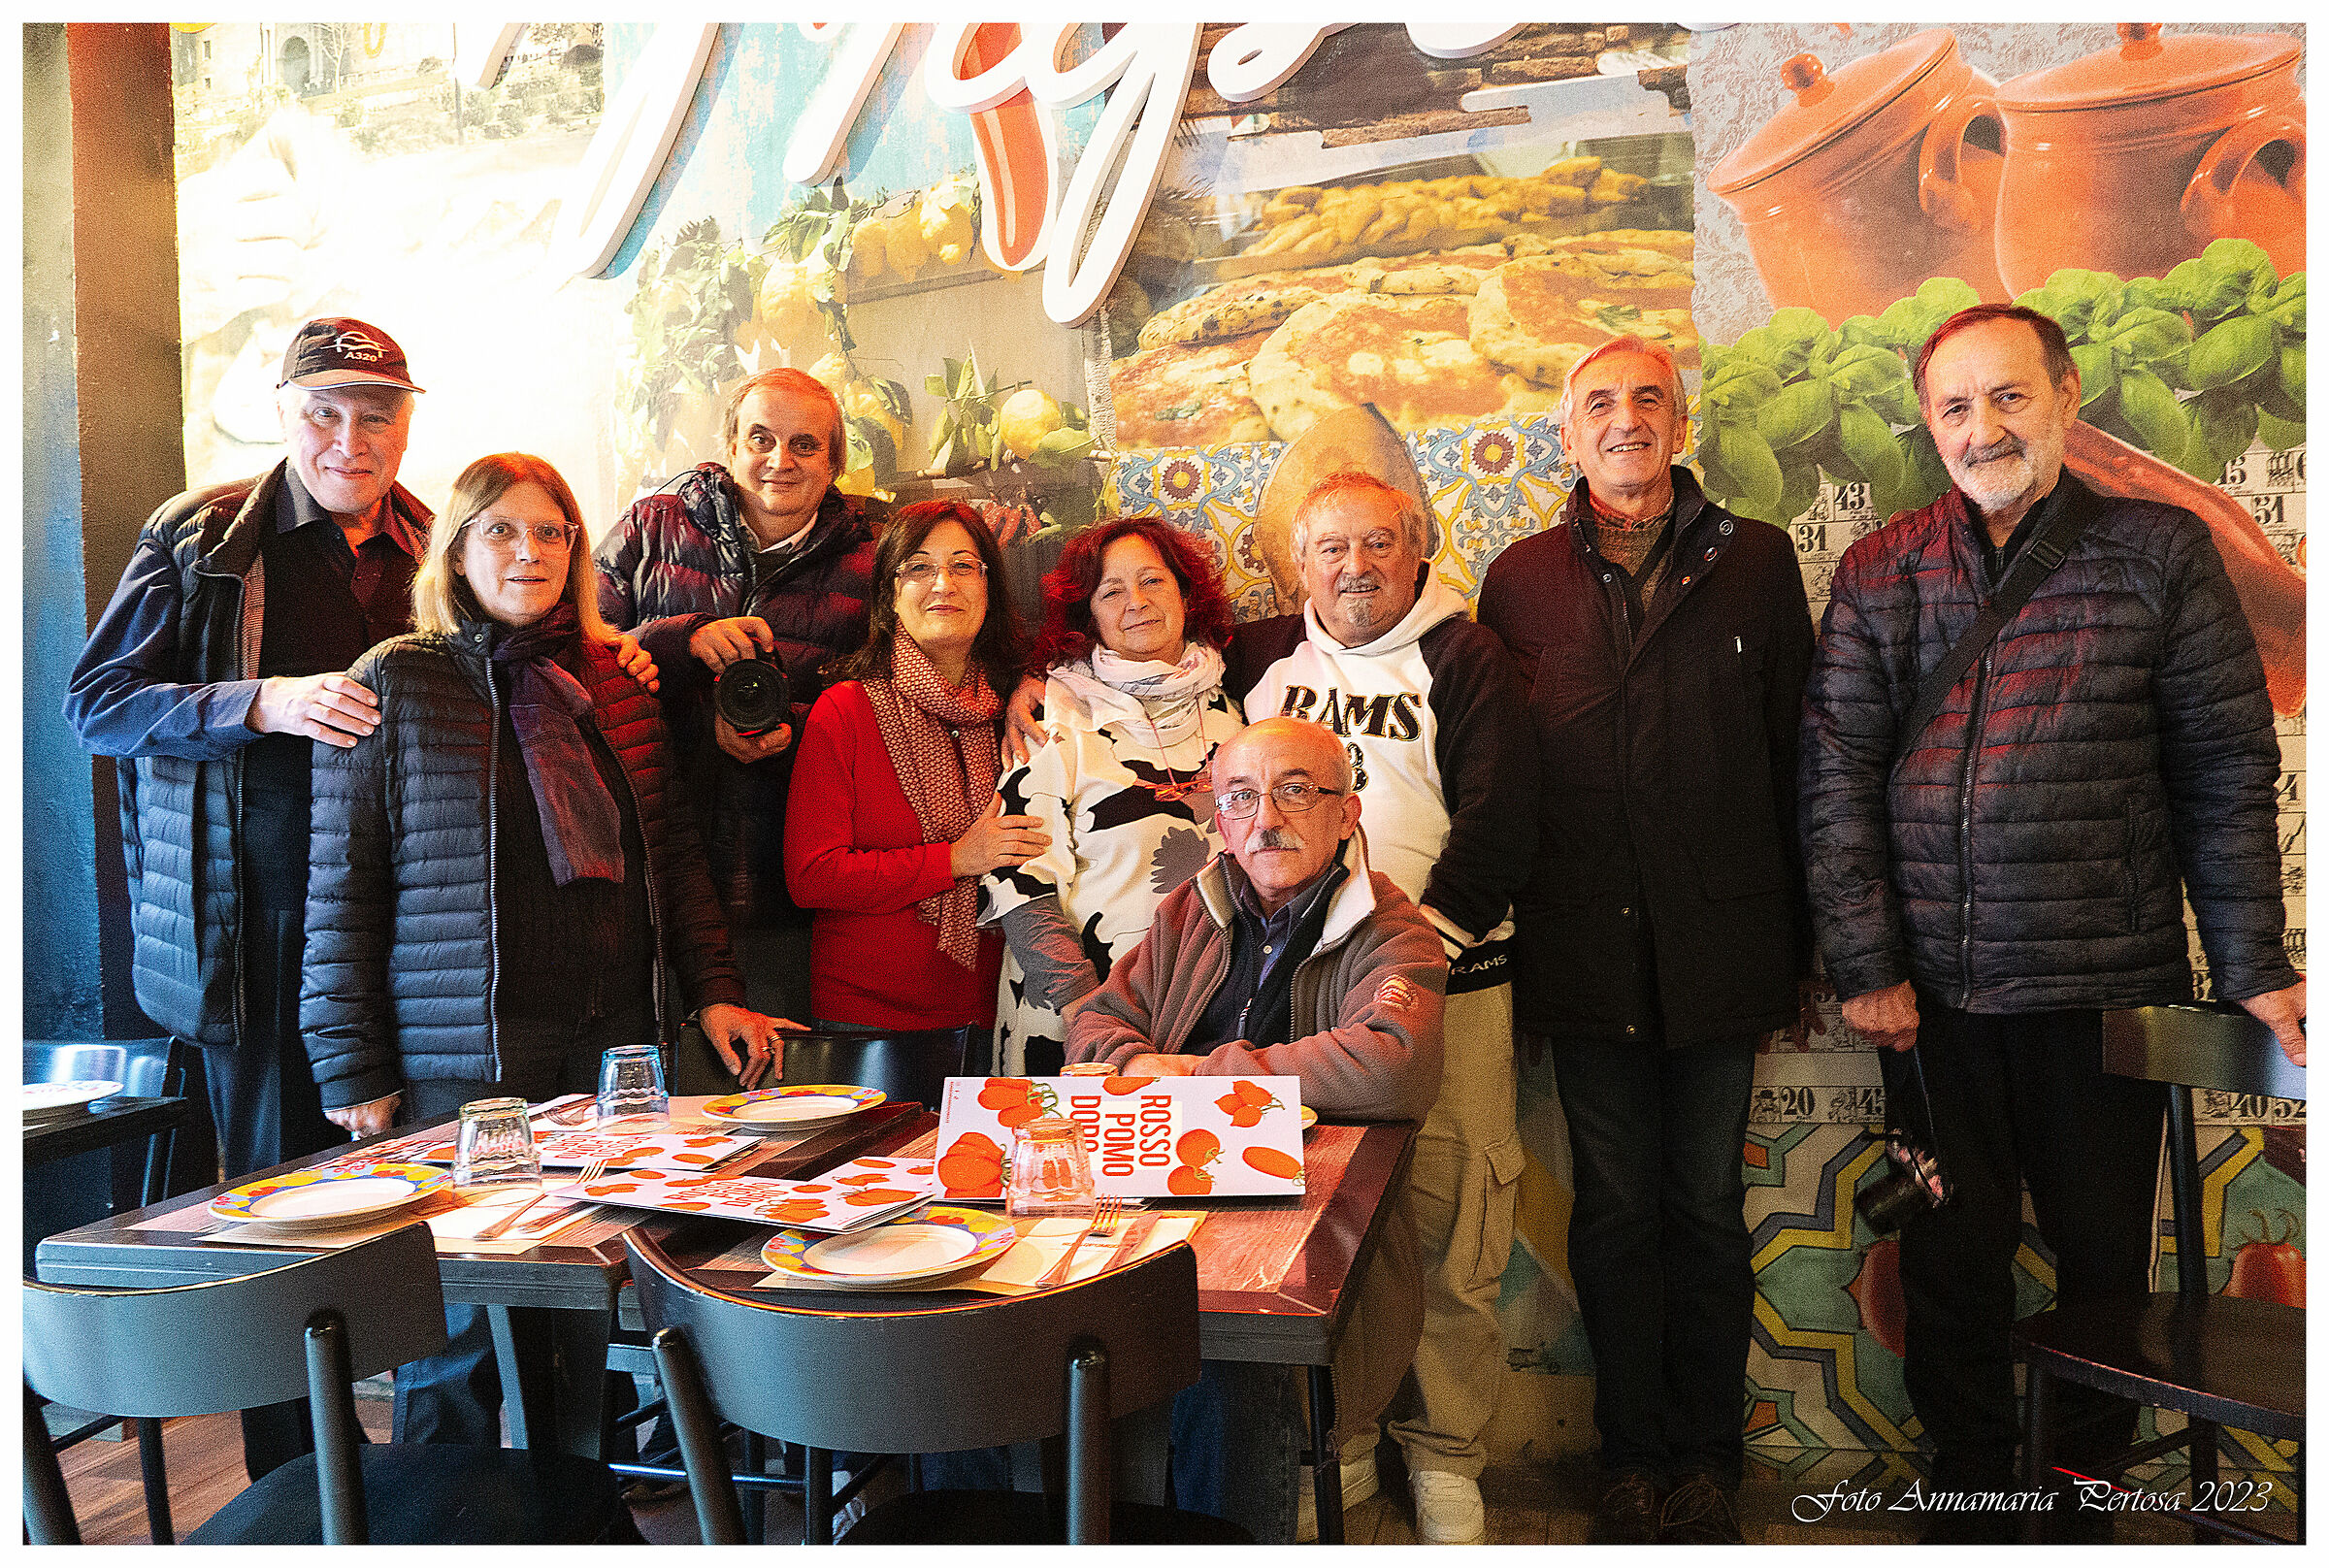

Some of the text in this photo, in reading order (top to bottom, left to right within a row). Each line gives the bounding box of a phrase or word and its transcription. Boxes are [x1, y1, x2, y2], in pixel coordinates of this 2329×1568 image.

[344, 350, 377, 363] A320
[1833, 481, 1865, 511] 43
[2253, 495, 2285, 525] 51
[1797, 524, 1828, 553] 31
[1279, 684, 1423, 742] RAMS
[1450, 954, 1508, 975] RAMS
[1781, 1086, 1816, 1117] 20
[2228, 1094, 2269, 1119] 40
[1101, 1113, 1136, 1177] POMO
[1138, 1094, 1172, 1167] ROSSO
